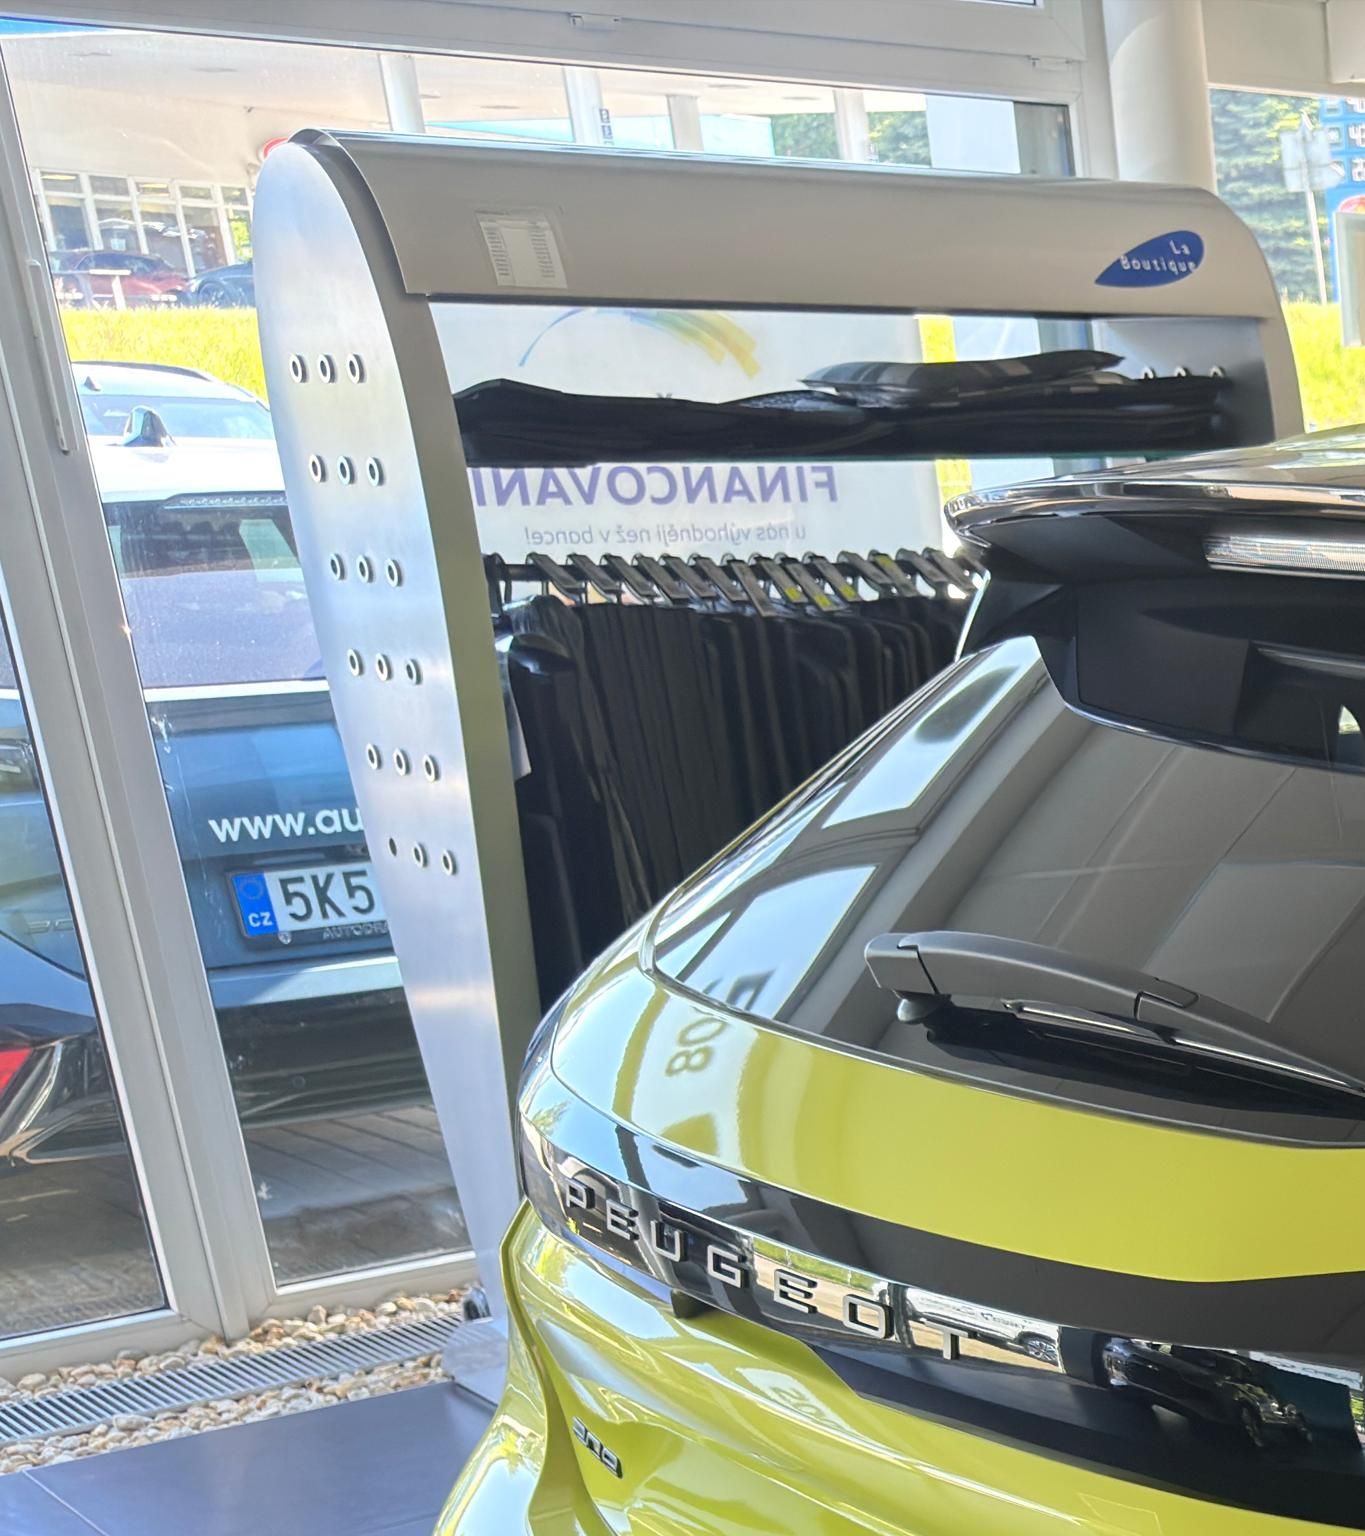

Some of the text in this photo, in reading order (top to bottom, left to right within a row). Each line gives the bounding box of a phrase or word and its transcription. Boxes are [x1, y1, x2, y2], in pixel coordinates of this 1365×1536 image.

[1169, 239, 1191, 255] La
[1120, 255, 1197, 276] Boutique
[279, 869, 377, 923] 5K5
[248, 911, 274, 928] CZ
[565, 1180, 970, 1362] PEUGEOT
